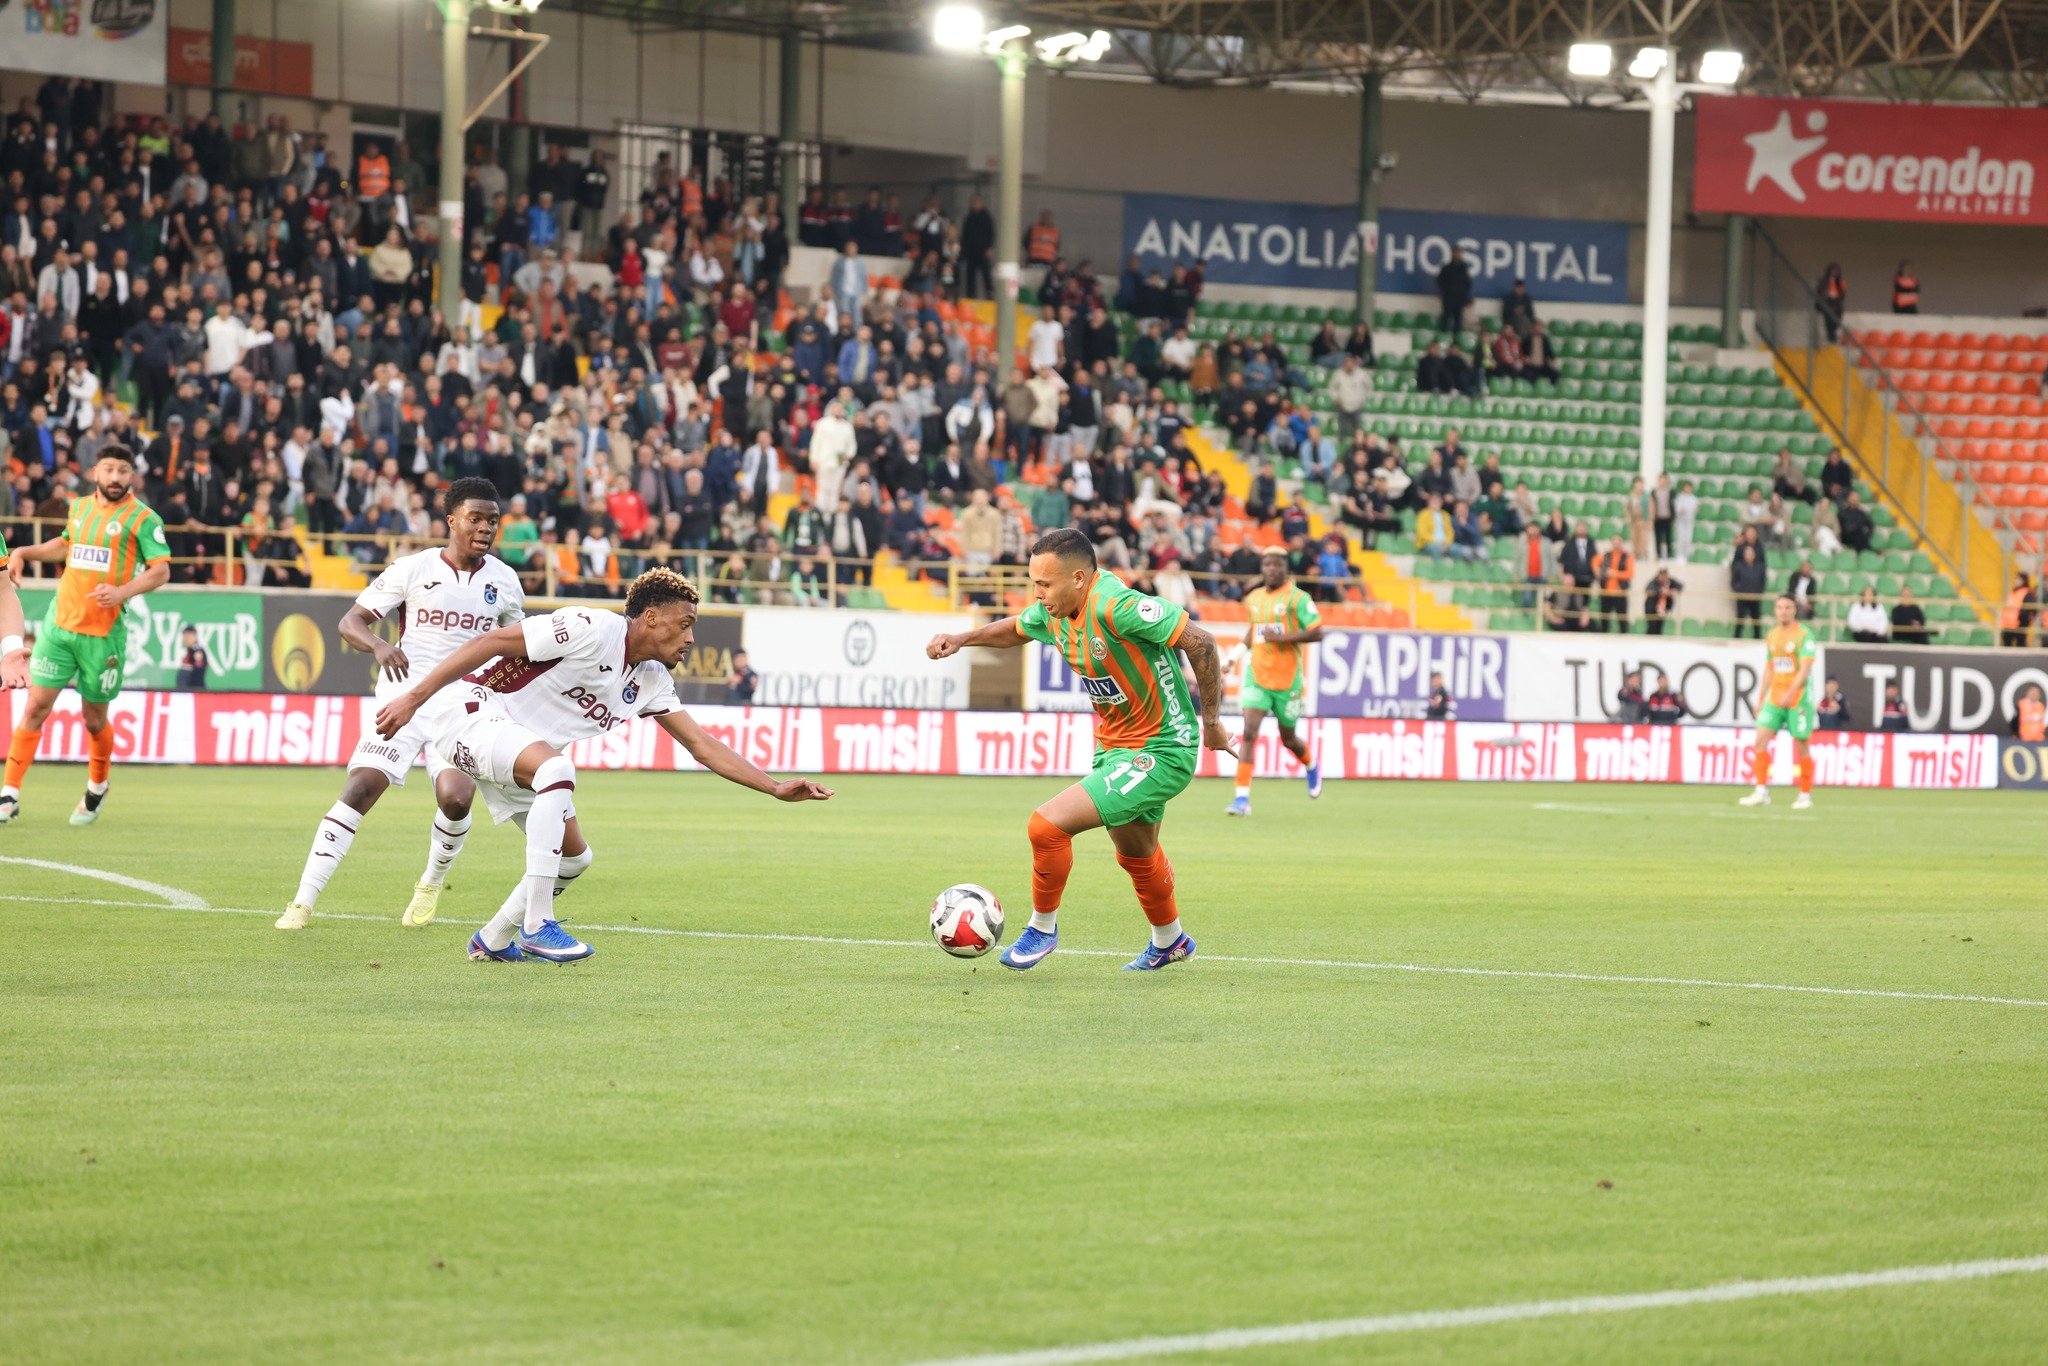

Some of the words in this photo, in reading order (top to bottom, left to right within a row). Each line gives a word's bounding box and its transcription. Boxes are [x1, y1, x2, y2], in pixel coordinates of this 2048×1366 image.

[1817, 147, 2034, 197] corendon
[1916, 195, 2031, 216] AIRLINES
[1134, 218, 1361, 269] ANATOLIA
[1385, 235, 1612, 284] HOSPITAL
[73, 546, 109, 563] TAV
[415, 608, 494, 633] papara
[552, 615, 569, 645] QNB
[99, 668, 118, 691] 10
[860, 674, 956, 708] GROUP
[42, 690, 169, 758] msli
[211, 695, 344, 763] misli
[561, 686, 626, 731] papar
[360, 741, 400, 763] RentGo
[834, 711, 944, 771] misli
[976, 711, 1076, 772] misli
[1353, 719, 1446, 778] misli
[1474, 722, 1558, 777] misli
[1584, 725, 1671, 780] misli
[1909, 734, 1983, 787] misli
